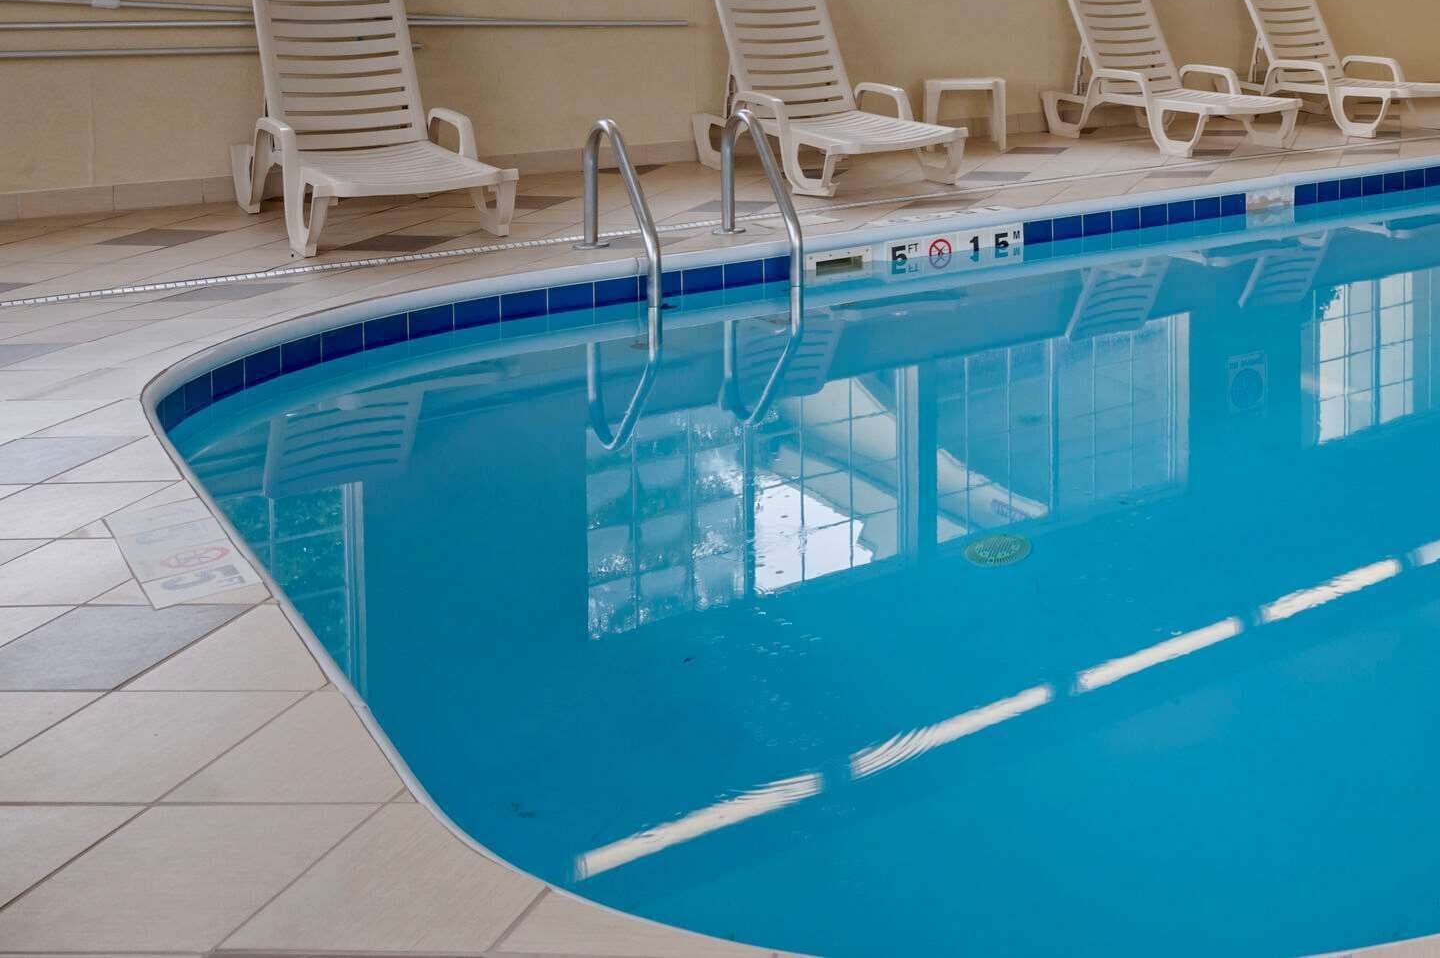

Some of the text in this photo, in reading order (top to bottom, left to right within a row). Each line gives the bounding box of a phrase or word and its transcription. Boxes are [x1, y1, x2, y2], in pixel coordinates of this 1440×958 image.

[891, 245, 907, 267] 5
[908, 243, 919, 252] FT
[1013, 230, 1020, 239] M
